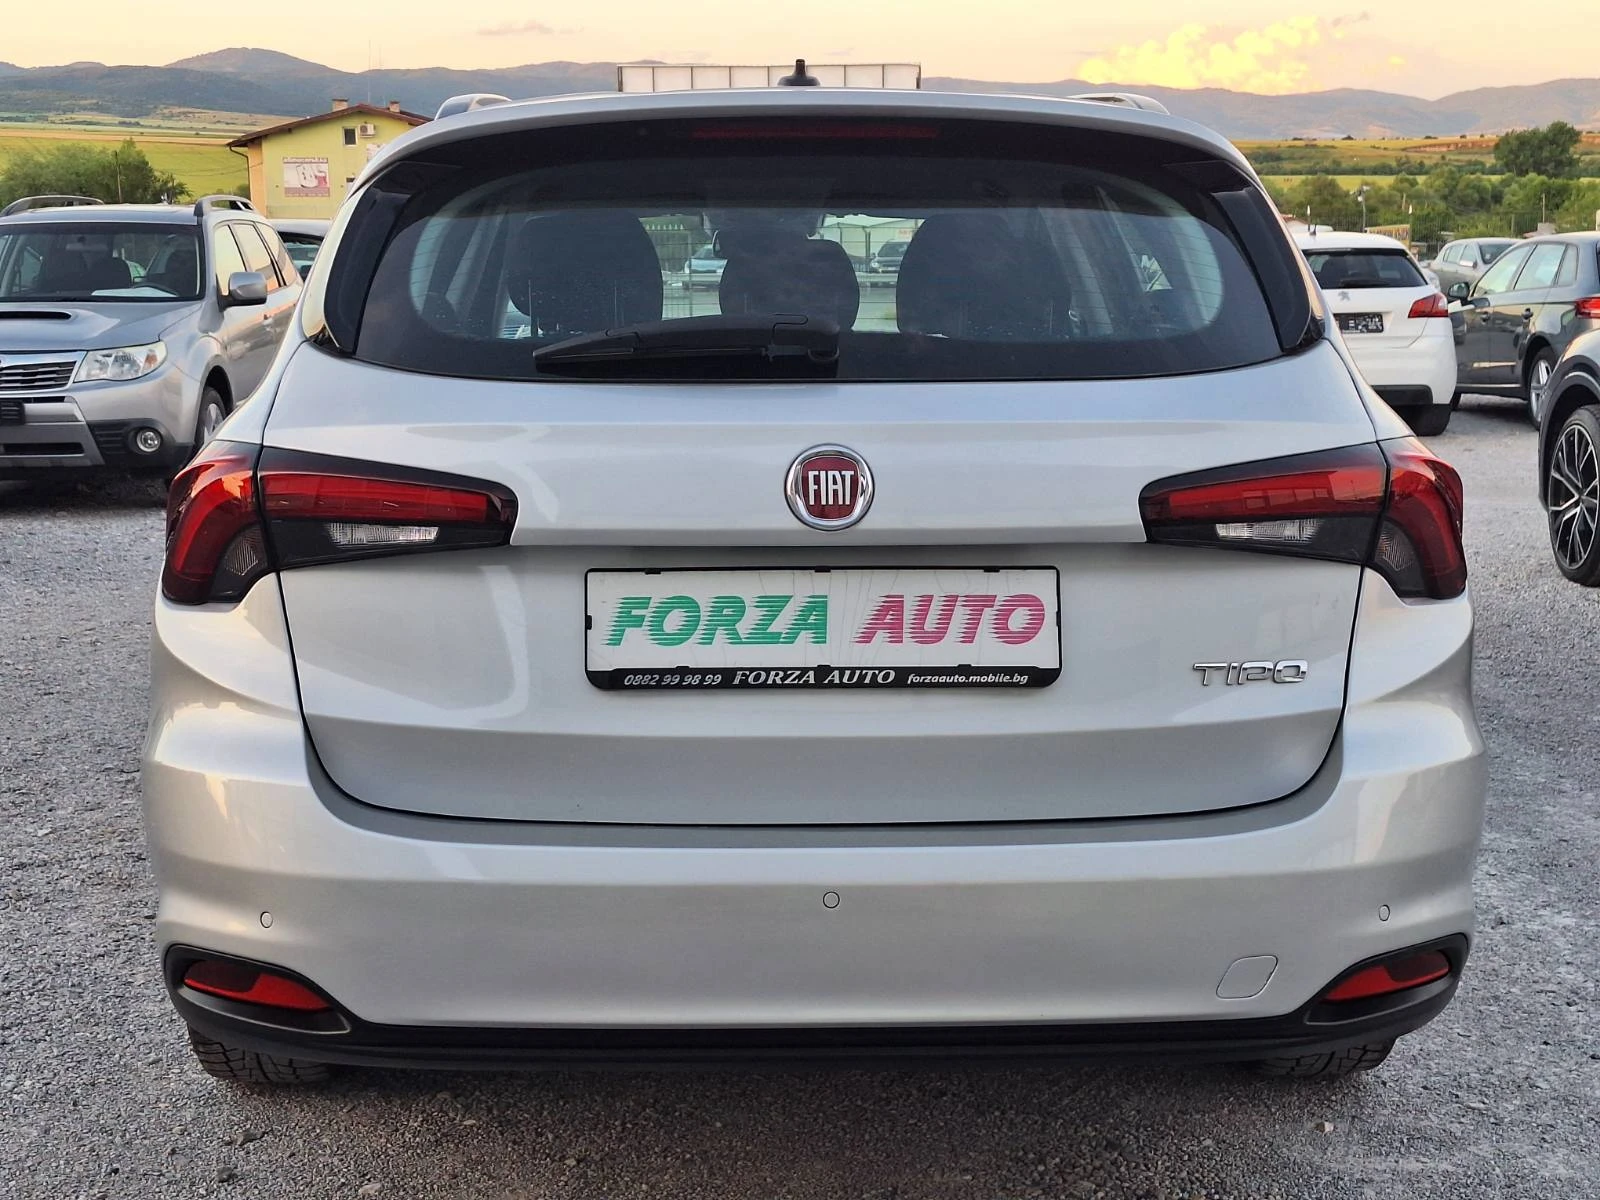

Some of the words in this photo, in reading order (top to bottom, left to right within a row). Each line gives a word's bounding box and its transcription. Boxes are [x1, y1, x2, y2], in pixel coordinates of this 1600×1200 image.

[807, 470, 855, 506] FIAT
[600, 594, 829, 647] FORZA
[850, 593, 1046, 645] AUTO
[623, 674, 660, 686] 0882
[661, 674, 681, 686] 99
[682, 674, 702, 686] 98
[703, 674, 722, 686] 99
[732, 670, 816, 685] FORZA
[823, 669, 896, 684] AUTO
[907, 673, 1029, 685] forzaauto.mobile.bg
[1193, 659, 1308, 686] TIPO
